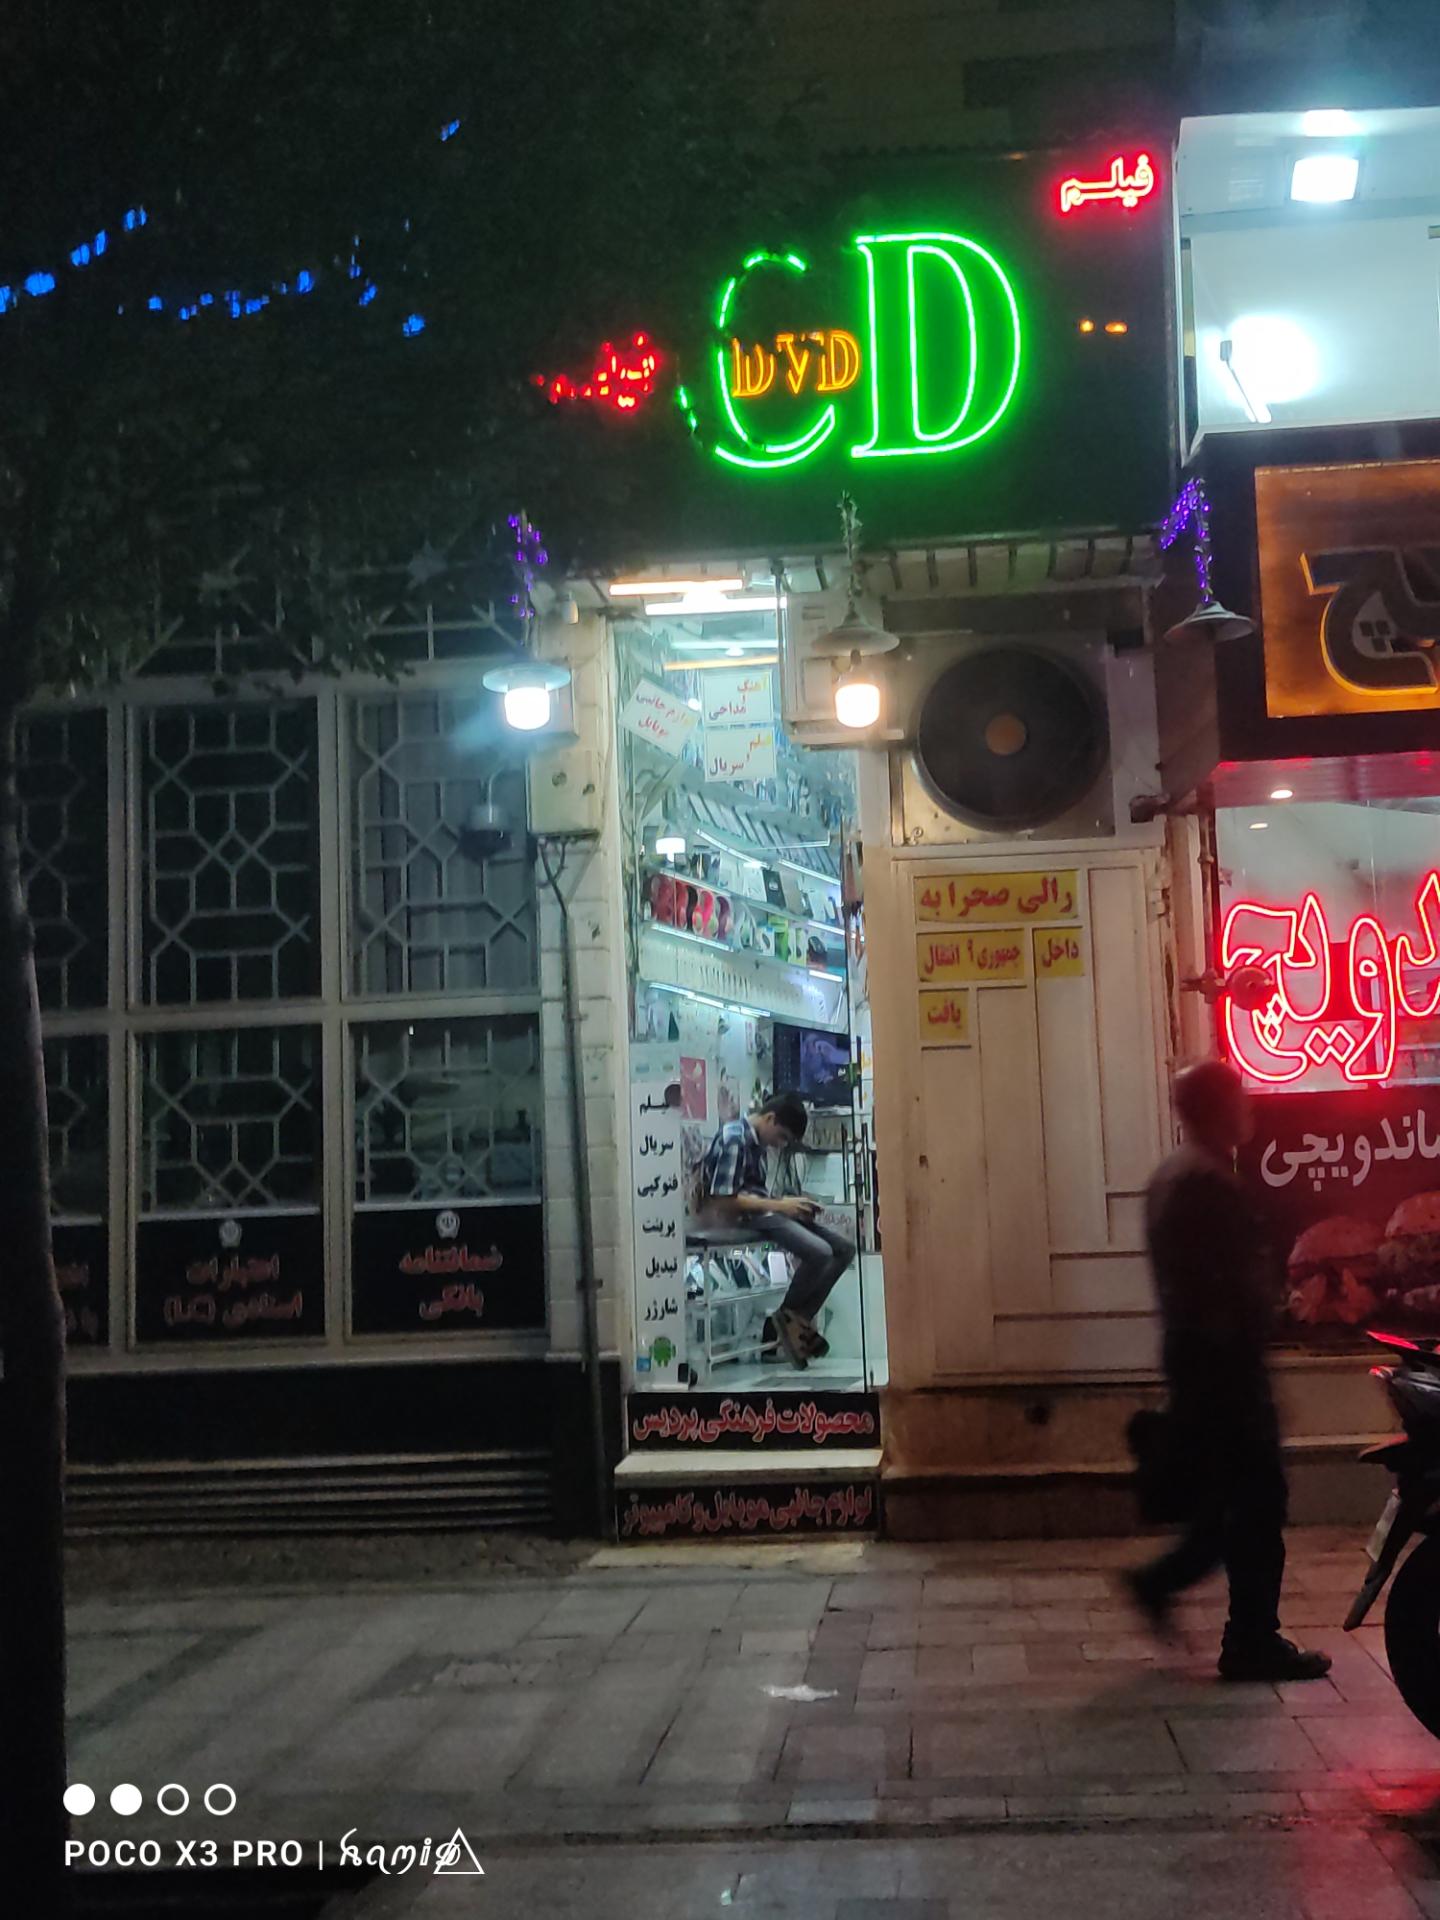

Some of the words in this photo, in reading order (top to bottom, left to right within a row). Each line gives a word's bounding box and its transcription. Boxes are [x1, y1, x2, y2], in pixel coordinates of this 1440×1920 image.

[1060, 154, 1154, 212] فیلم
[676, 231, 1022, 470] CD
[731, 328, 860, 398] DVD
[948, 881, 1010, 917] صحرا
[639, 1134, 674, 1156] سریال
[644, 1297, 678, 1321] شارژر
[633, 1406, 699, 1442] پردیس
[701, 1397, 776, 1443] فرهنگی
[776, 1401, 874, 1443] محصولات
